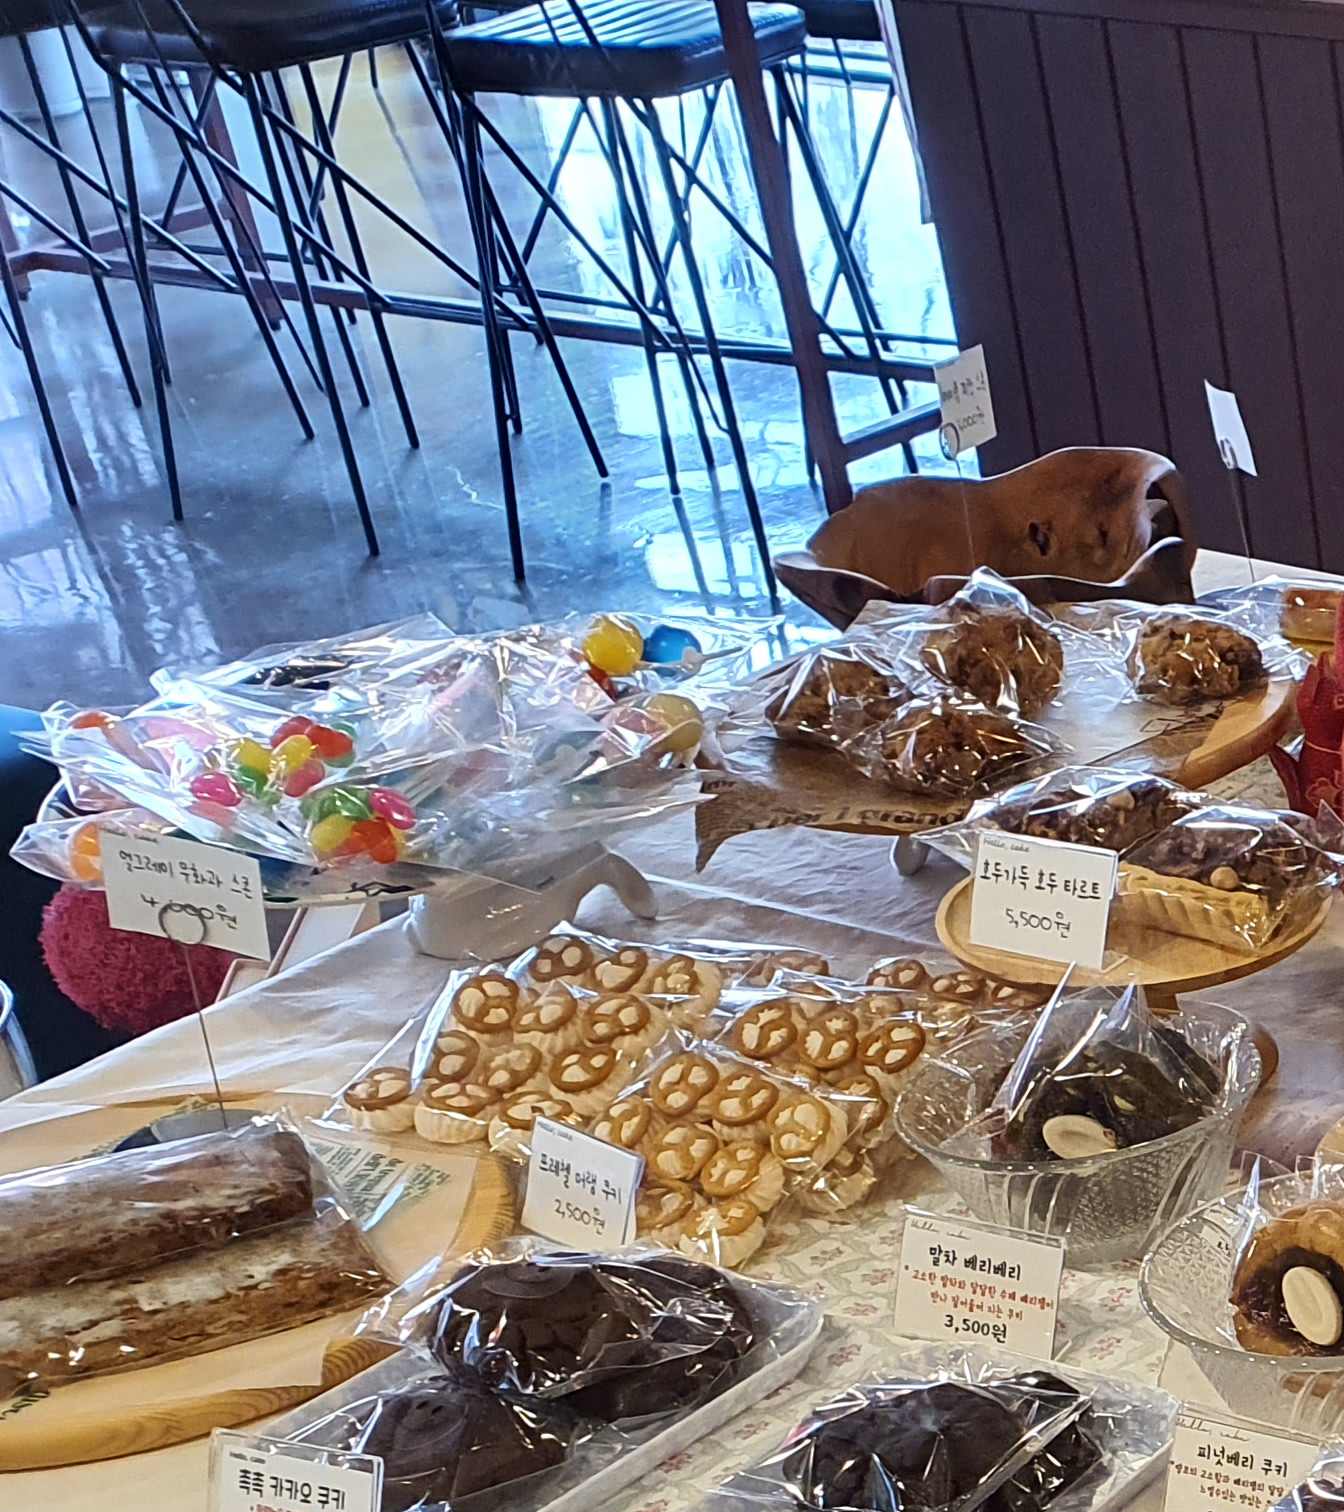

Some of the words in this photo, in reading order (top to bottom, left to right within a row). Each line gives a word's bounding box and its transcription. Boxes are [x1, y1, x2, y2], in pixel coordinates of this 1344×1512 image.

[119, 850, 173, 877] 얼그레이
[179, 862, 223, 887] 무화과
[231, 873, 253, 899] 스콘
[980, 859, 1030, 890] 호두가득
[1035, 869, 1058, 894] 호두
[1063, 878, 1101, 900] 타르트
[1005, 908, 1071, 938] 5,500원
[539, 1153, 571, 1189] 프레첼
[575, 1171, 598, 1195] 머랭
[601, 1179, 622, 1205] 쿠키
[554, 1198, 605, 1235] 2,500원
[928, 1244, 957, 1267] 말차
[963, 1254, 1021, 1281] 베리베리
[944, 1314, 1007, 1343] 3,500원
[1197, 1444, 1254, 1470] 피넛베리
[1261, 1458, 1288, 1478] 쿠키
[239, 1469, 265, 1498] 촉촉
[269, 1475, 312, 1504] 카카오
[317, 1486, 346, 1510] 쿠키
